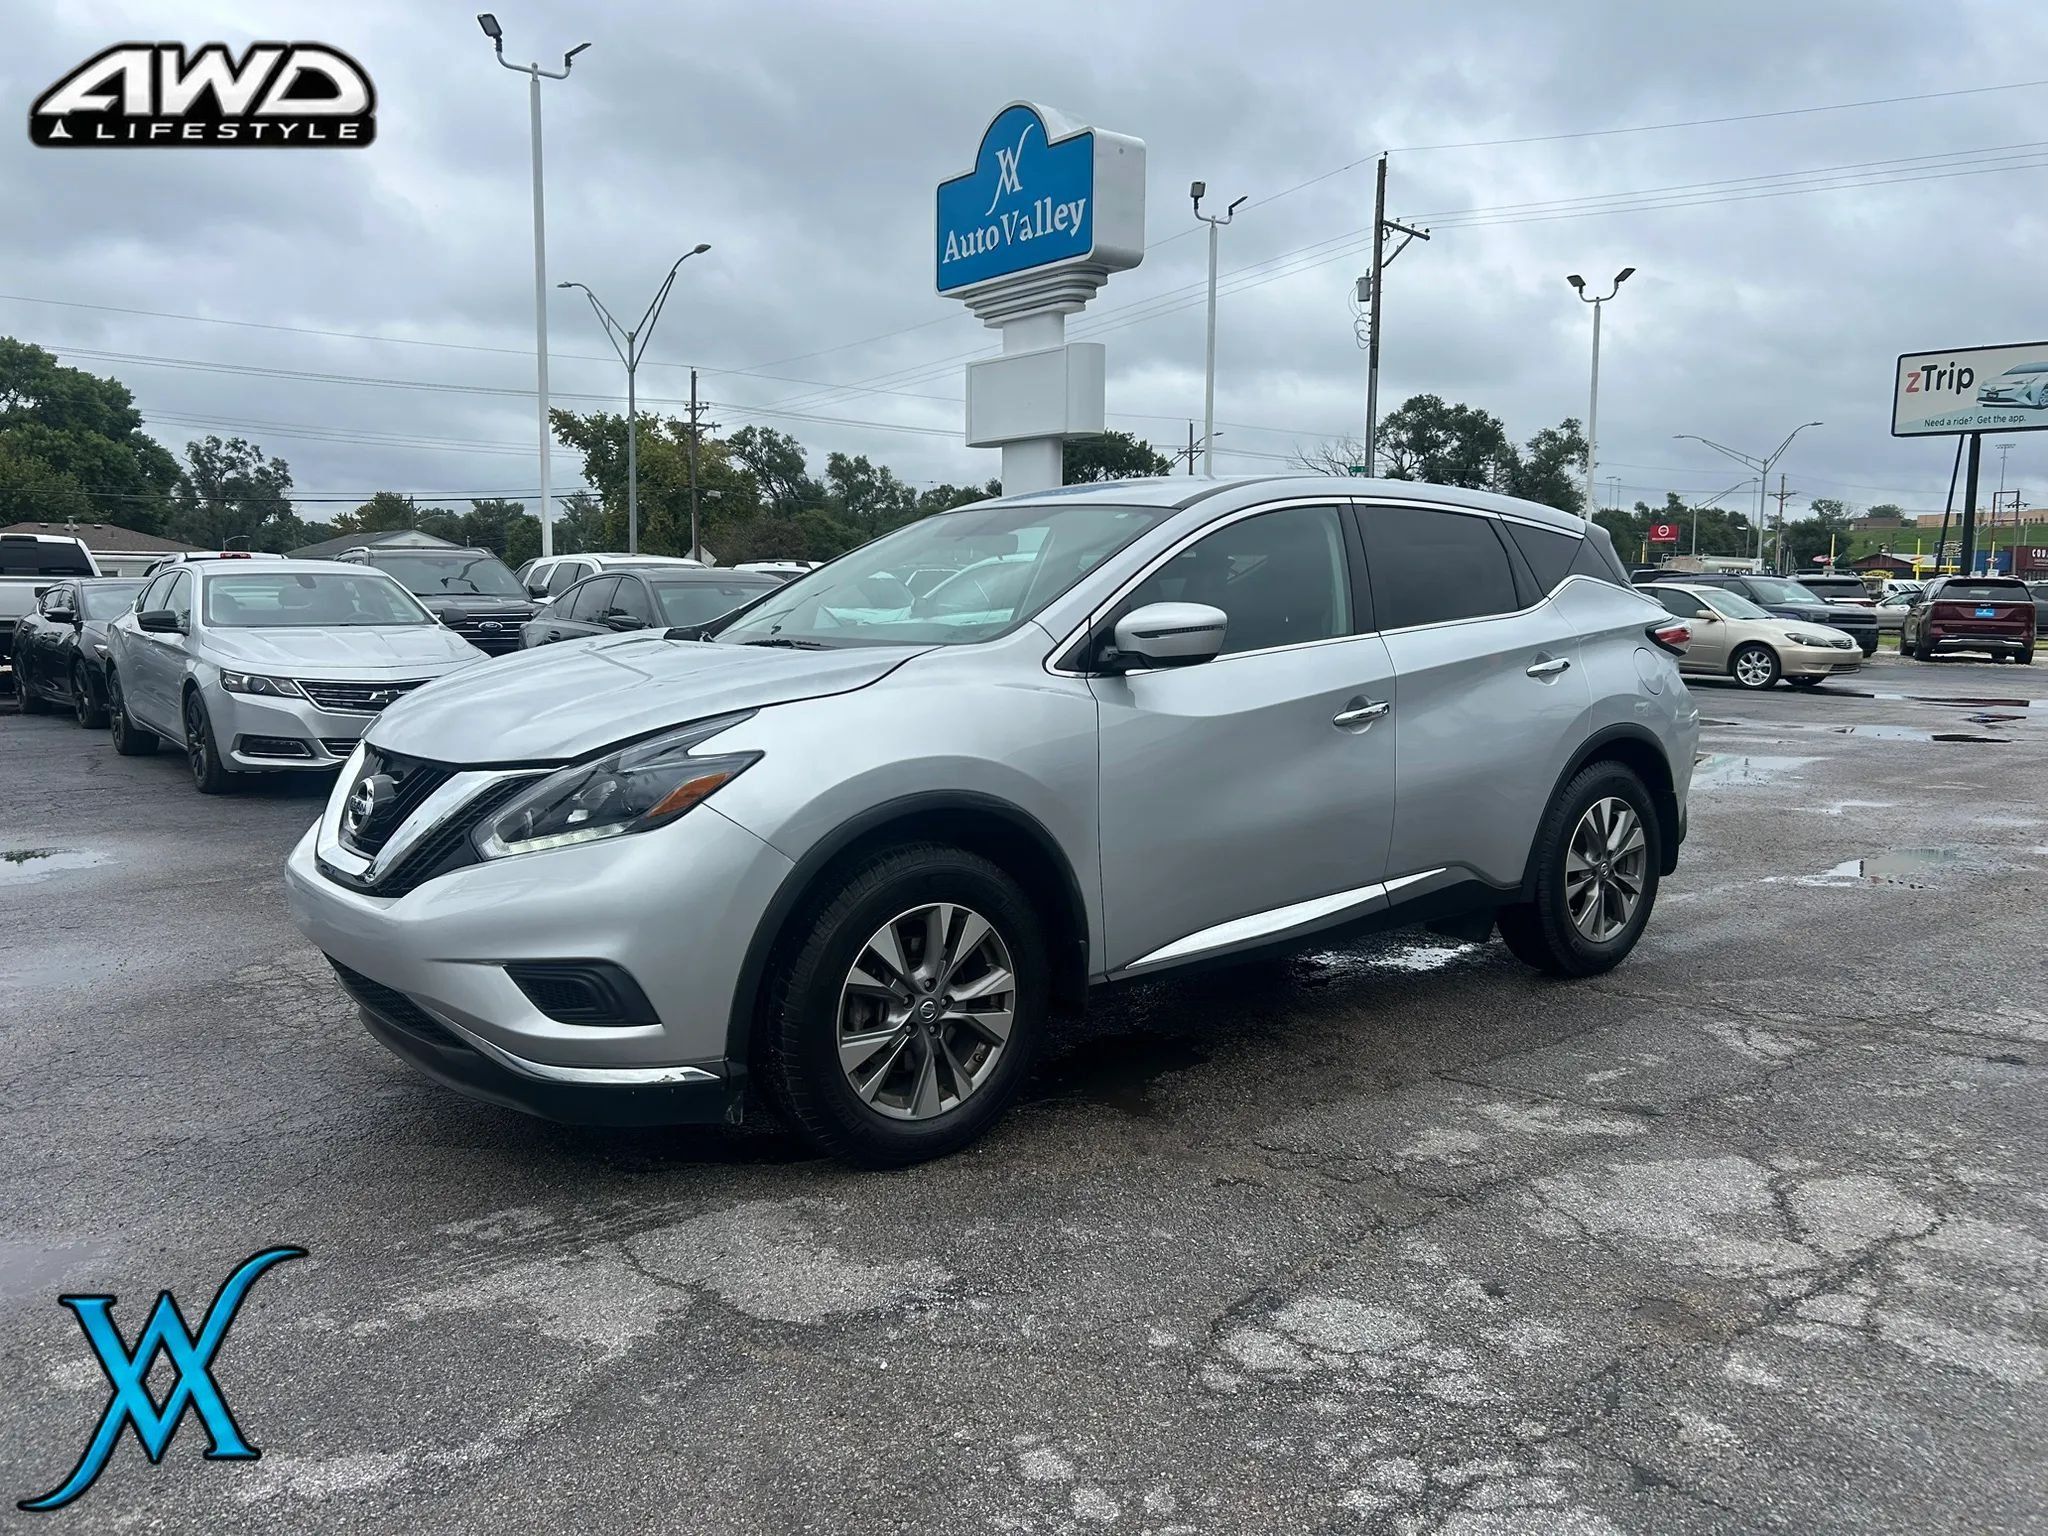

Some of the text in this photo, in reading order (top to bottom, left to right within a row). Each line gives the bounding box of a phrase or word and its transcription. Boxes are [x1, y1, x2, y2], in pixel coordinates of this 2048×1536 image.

[1905, 361, 1975, 395] zTrip
[1924, 418, 1945, 427] Need
[1953, 416, 1973, 425] ride?
[1977, 415, 1991, 424] Get
[1993, 415, 2007, 424] the
